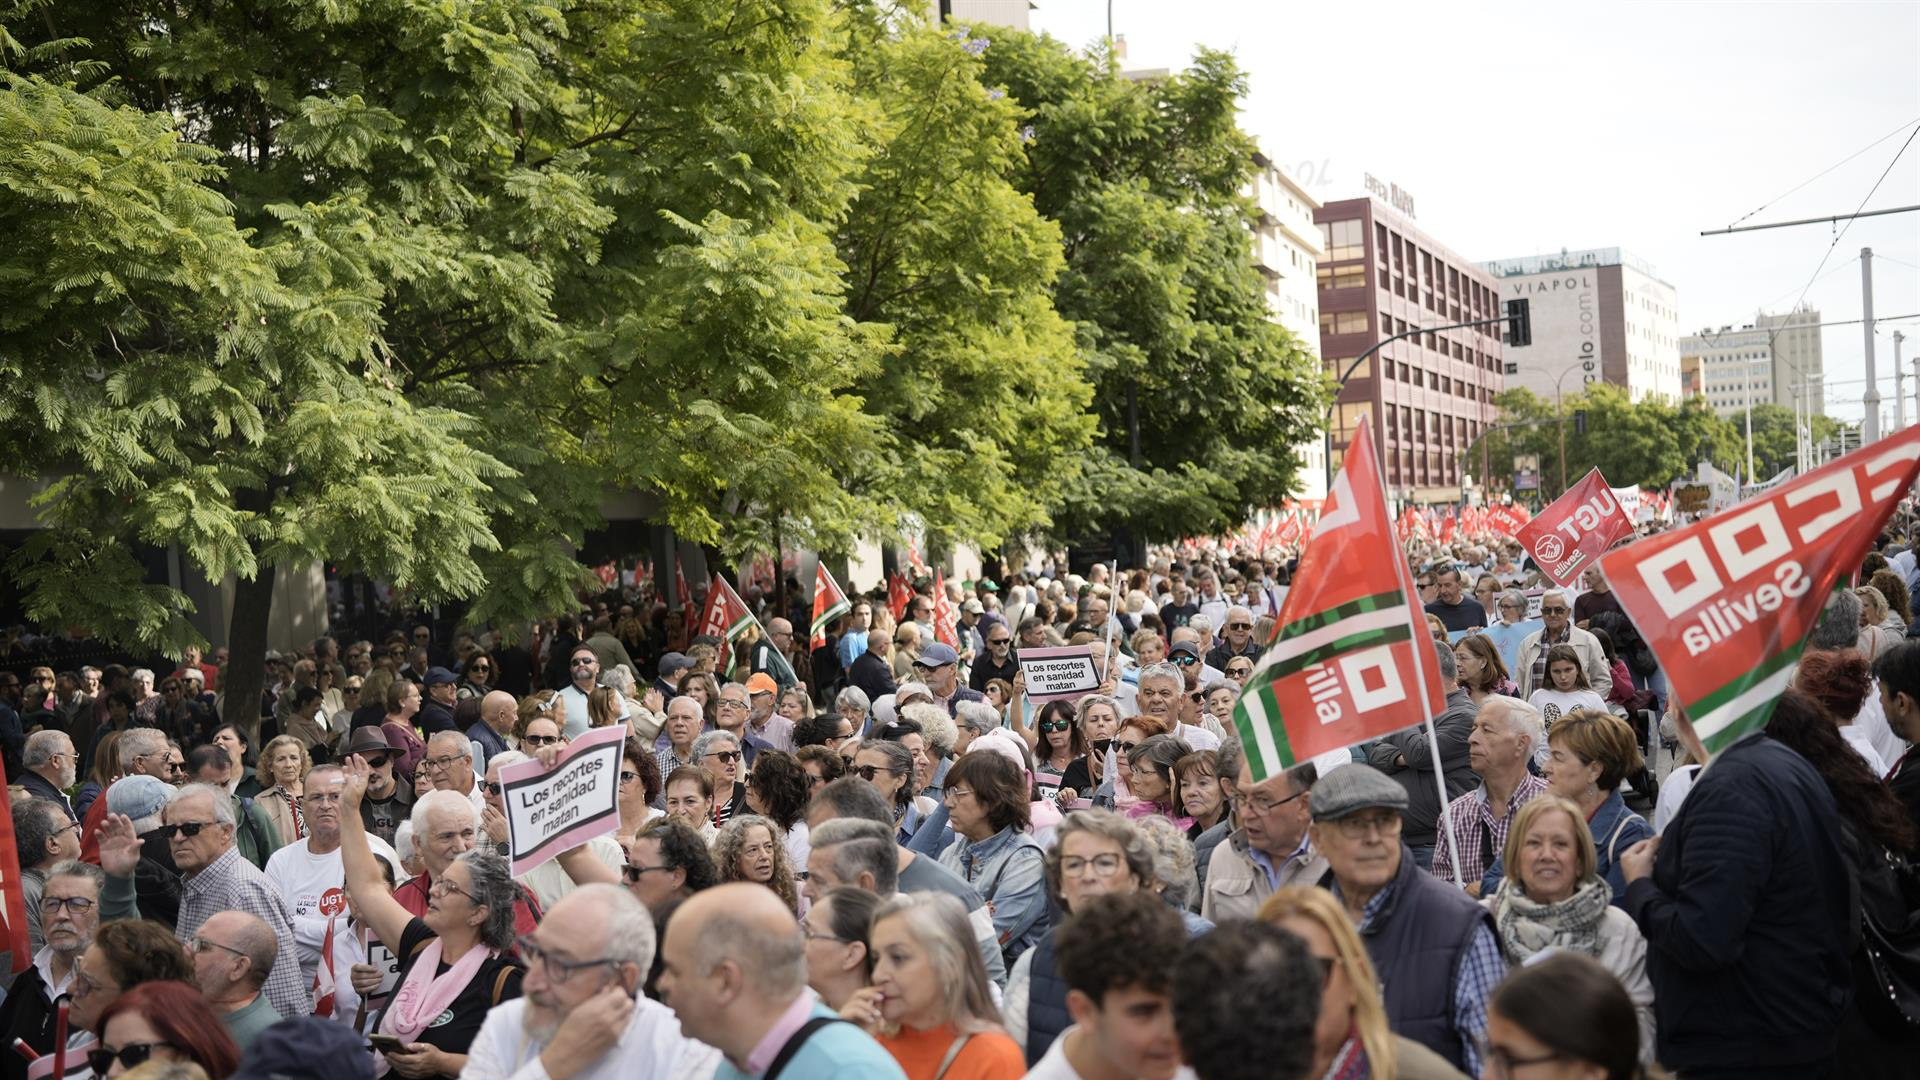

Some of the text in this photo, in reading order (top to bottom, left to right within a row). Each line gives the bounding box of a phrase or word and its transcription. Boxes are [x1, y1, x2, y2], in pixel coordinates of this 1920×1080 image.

[1514, 277, 1591, 294] VIAPOL
[1027, 661, 1086, 672] Los recortes
[1033, 670, 1085, 682] en sanidad
[1046, 681, 1076, 691] matan
[521, 758, 604, 808] Los recortes
[530, 775, 597, 824] en sanidad
[542, 805, 579, 836] matan
[321, 893, 344, 907] UGT
[296, 907, 306, 915] NO
